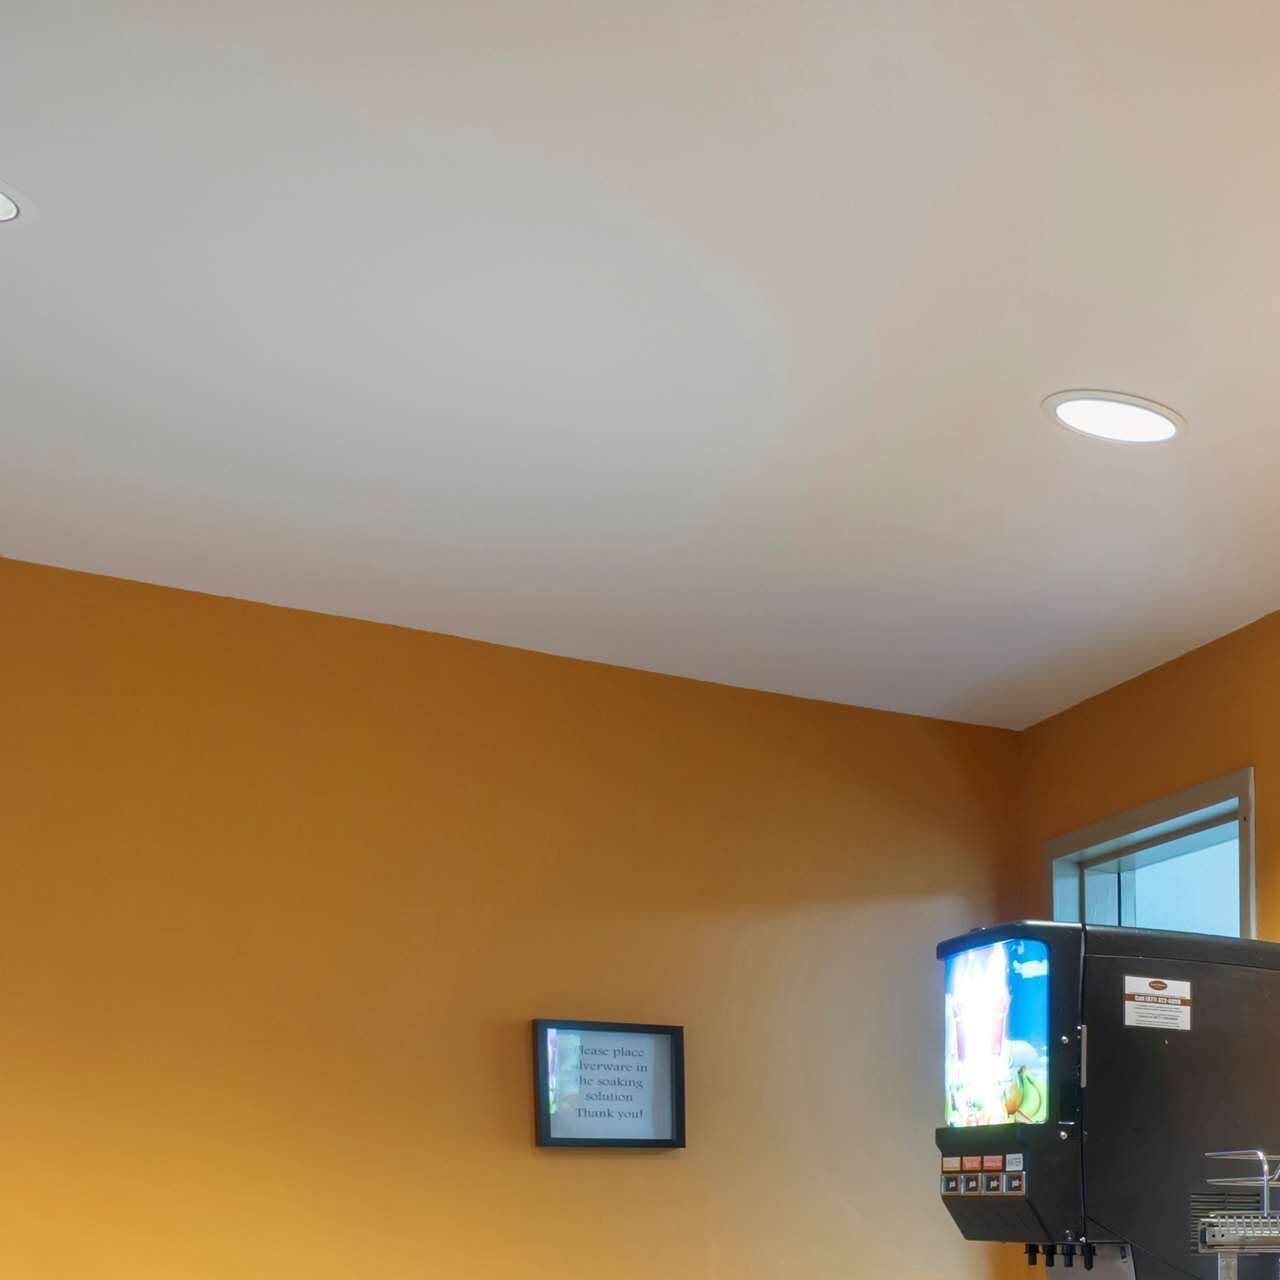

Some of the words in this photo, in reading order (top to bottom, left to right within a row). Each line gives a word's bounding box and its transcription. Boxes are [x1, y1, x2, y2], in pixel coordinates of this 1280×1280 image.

[613, 1046, 645, 1059] place
[636, 1064, 648, 1073] in
[597, 1077, 644, 1089] soaking
[585, 1091, 633, 1102] solution
[577, 1107, 614, 1118] Thank
[618, 1109, 644, 1121] you!
